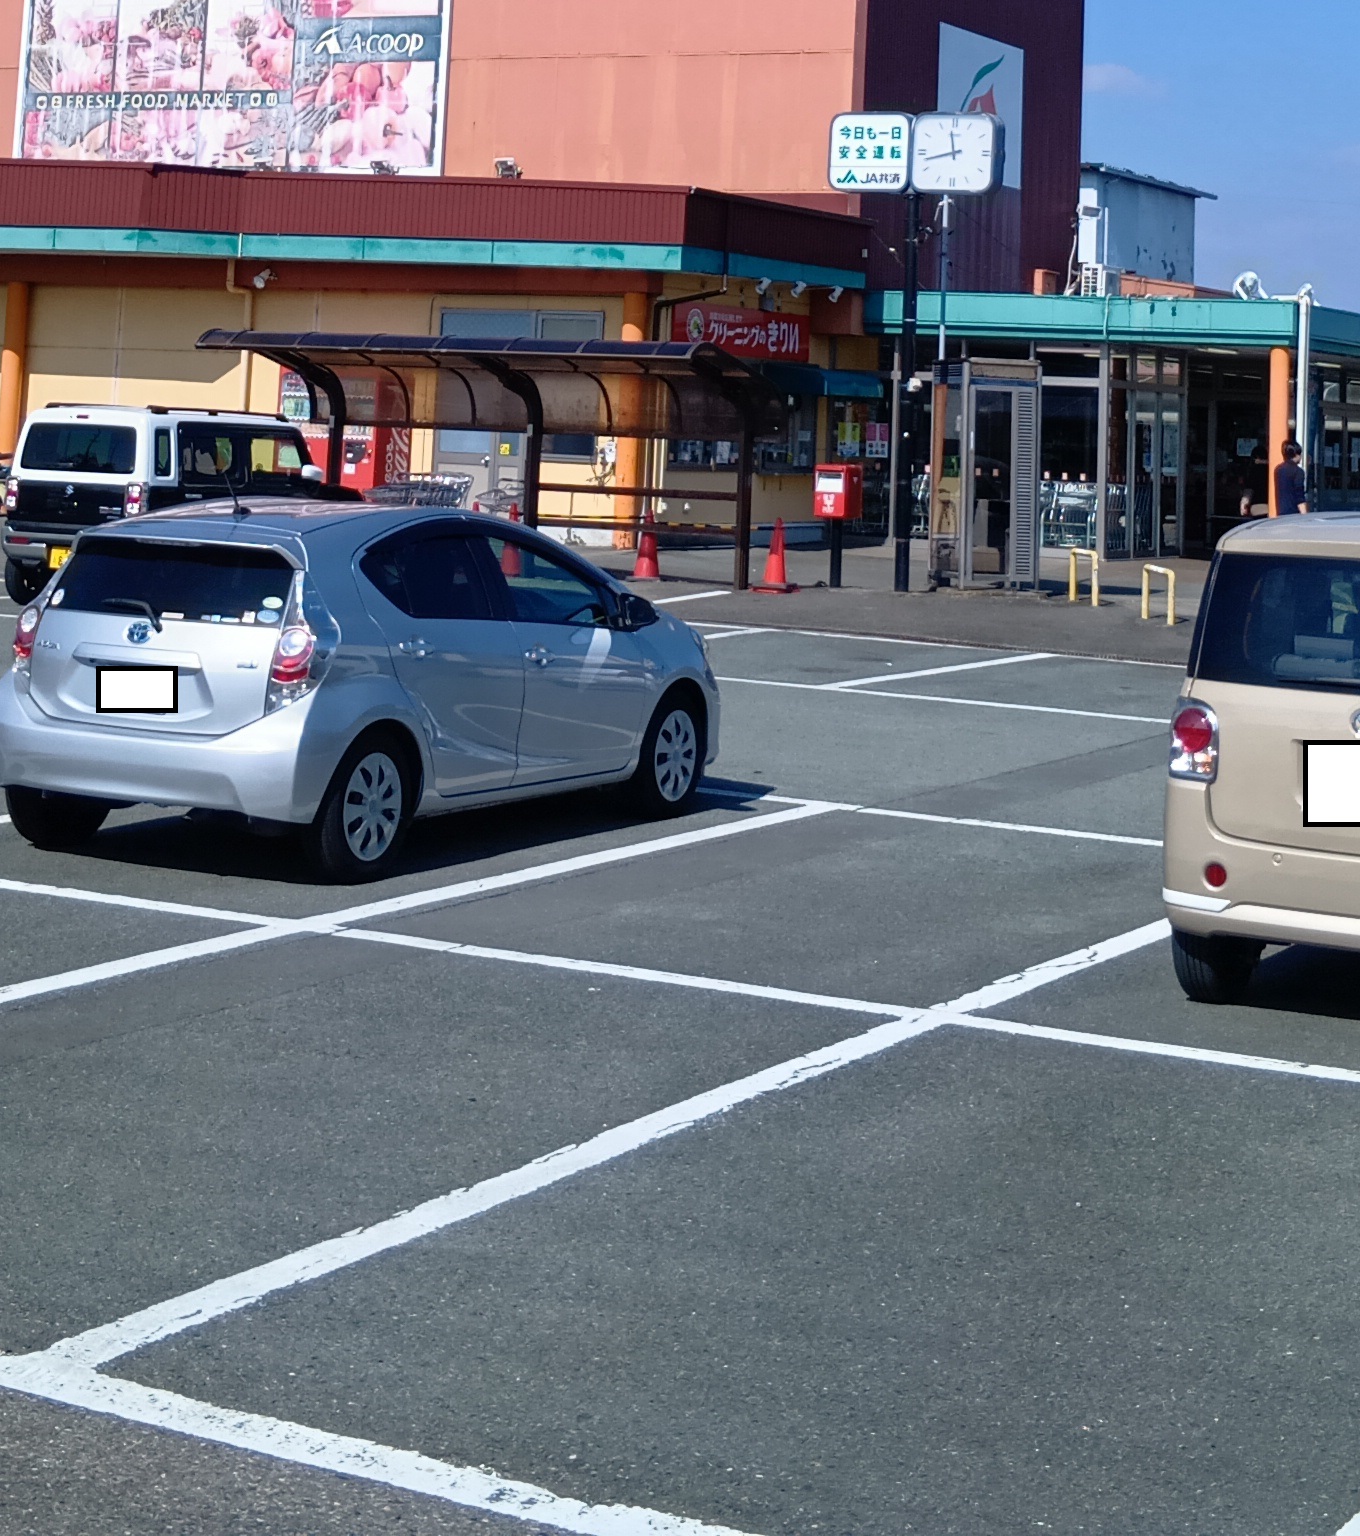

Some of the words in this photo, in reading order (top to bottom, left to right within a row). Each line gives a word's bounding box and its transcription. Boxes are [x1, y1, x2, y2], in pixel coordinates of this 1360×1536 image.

[65, 94, 116, 109] FRESH
[122, 93, 169, 109] FOOD
[175, 92, 244, 109] MARKET
[839, 125, 902, 140] 今日も一日
[839, 145, 902, 159] 安全運転
[860, 172, 901, 184] JA共済
